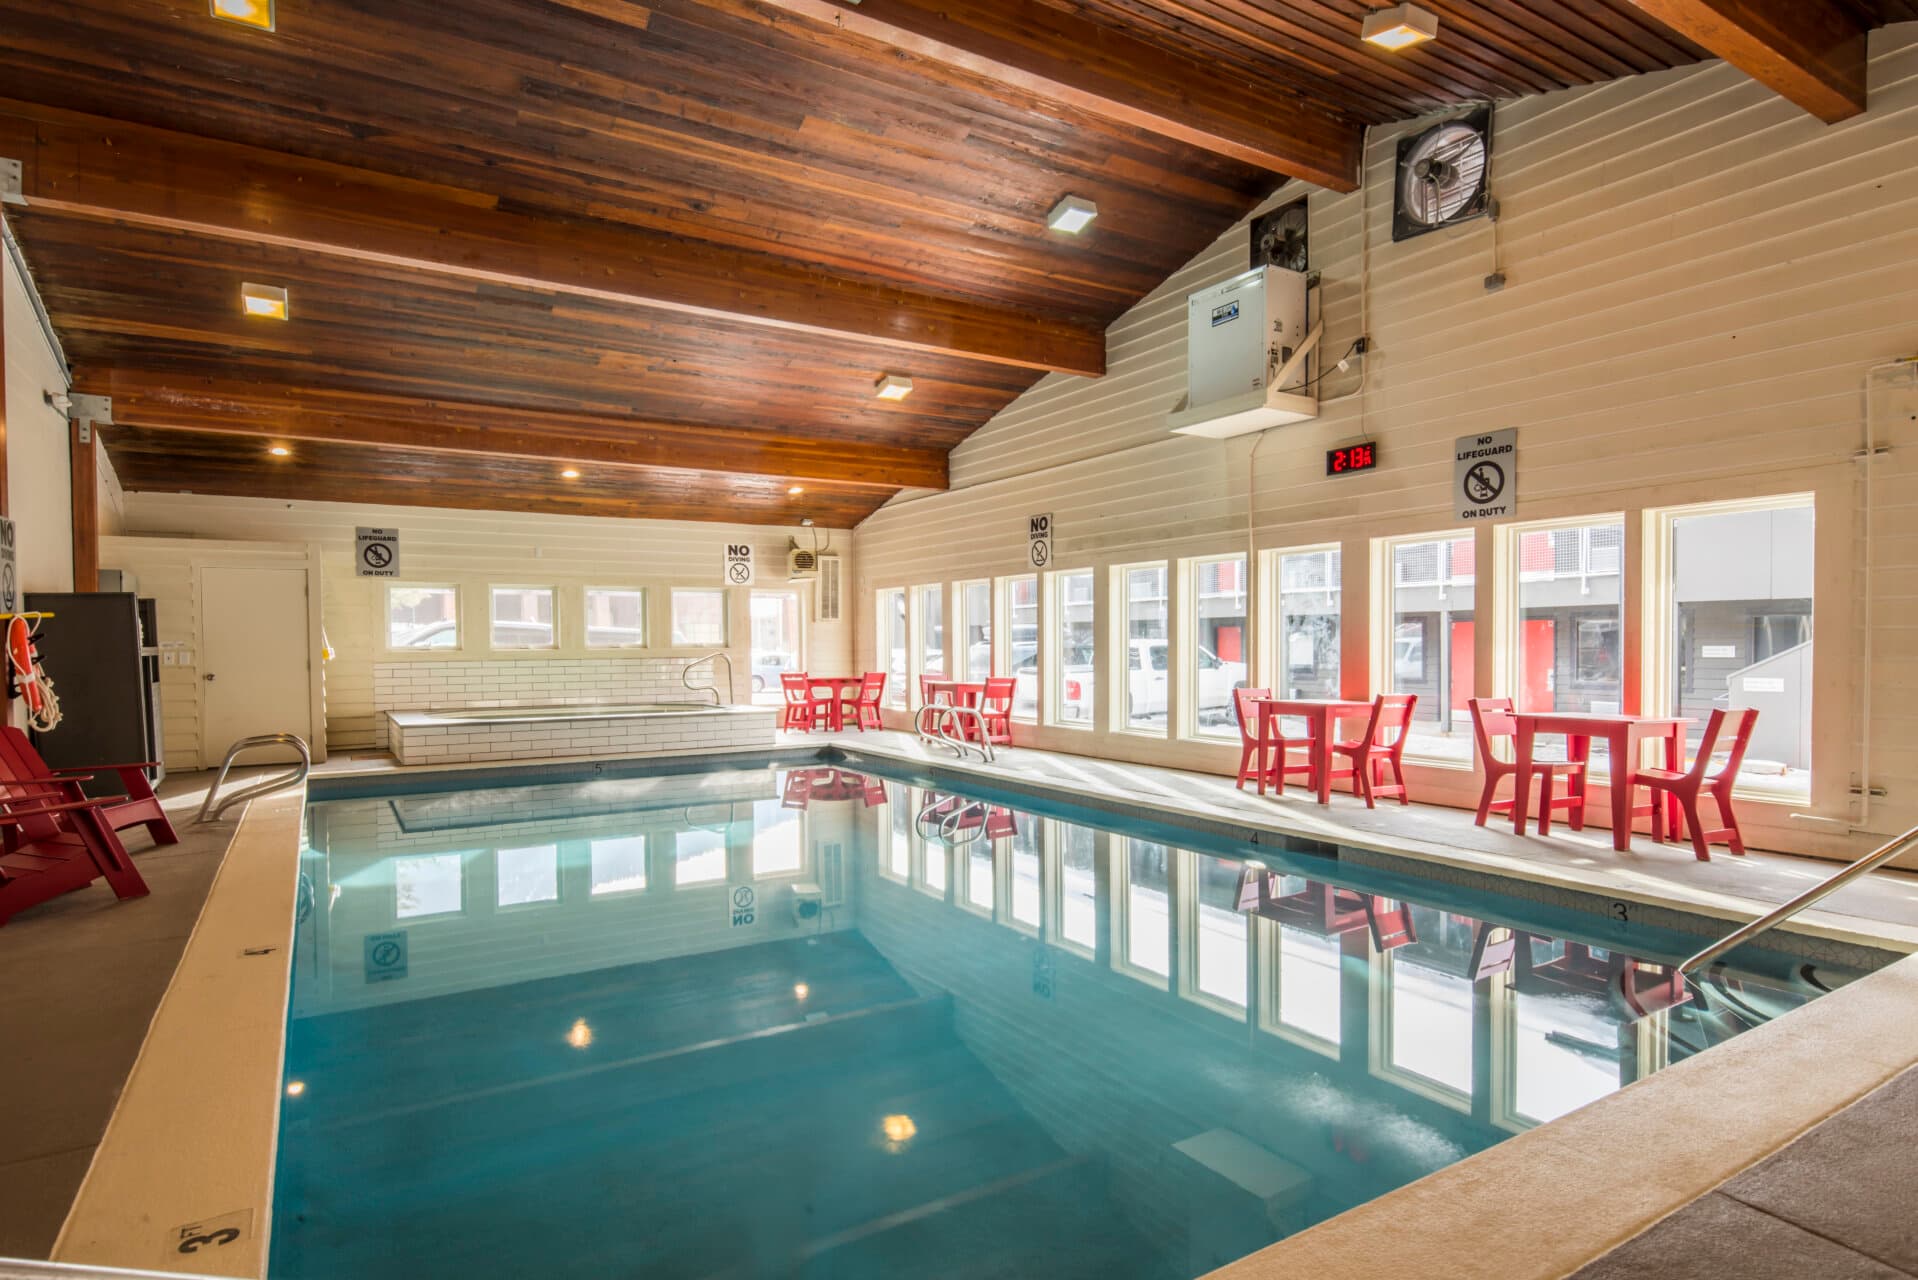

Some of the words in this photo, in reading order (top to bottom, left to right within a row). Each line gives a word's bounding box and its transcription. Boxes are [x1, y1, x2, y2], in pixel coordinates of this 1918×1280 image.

[1477, 436, 1493, 445] NO
[1333, 447, 1364, 472] 2:13
[1457, 444, 1513, 460] LIFEGUARD
[1462, 510, 1477, 519] ON
[1479, 506, 1506, 517] DUTY
[1031, 516, 1048, 532] NO
[1030, 532, 1048, 540] DIVING
[728, 544, 750, 556] NO
[1613, 902, 1628, 921] 3
[177, 1227, 241, 1254] 3
